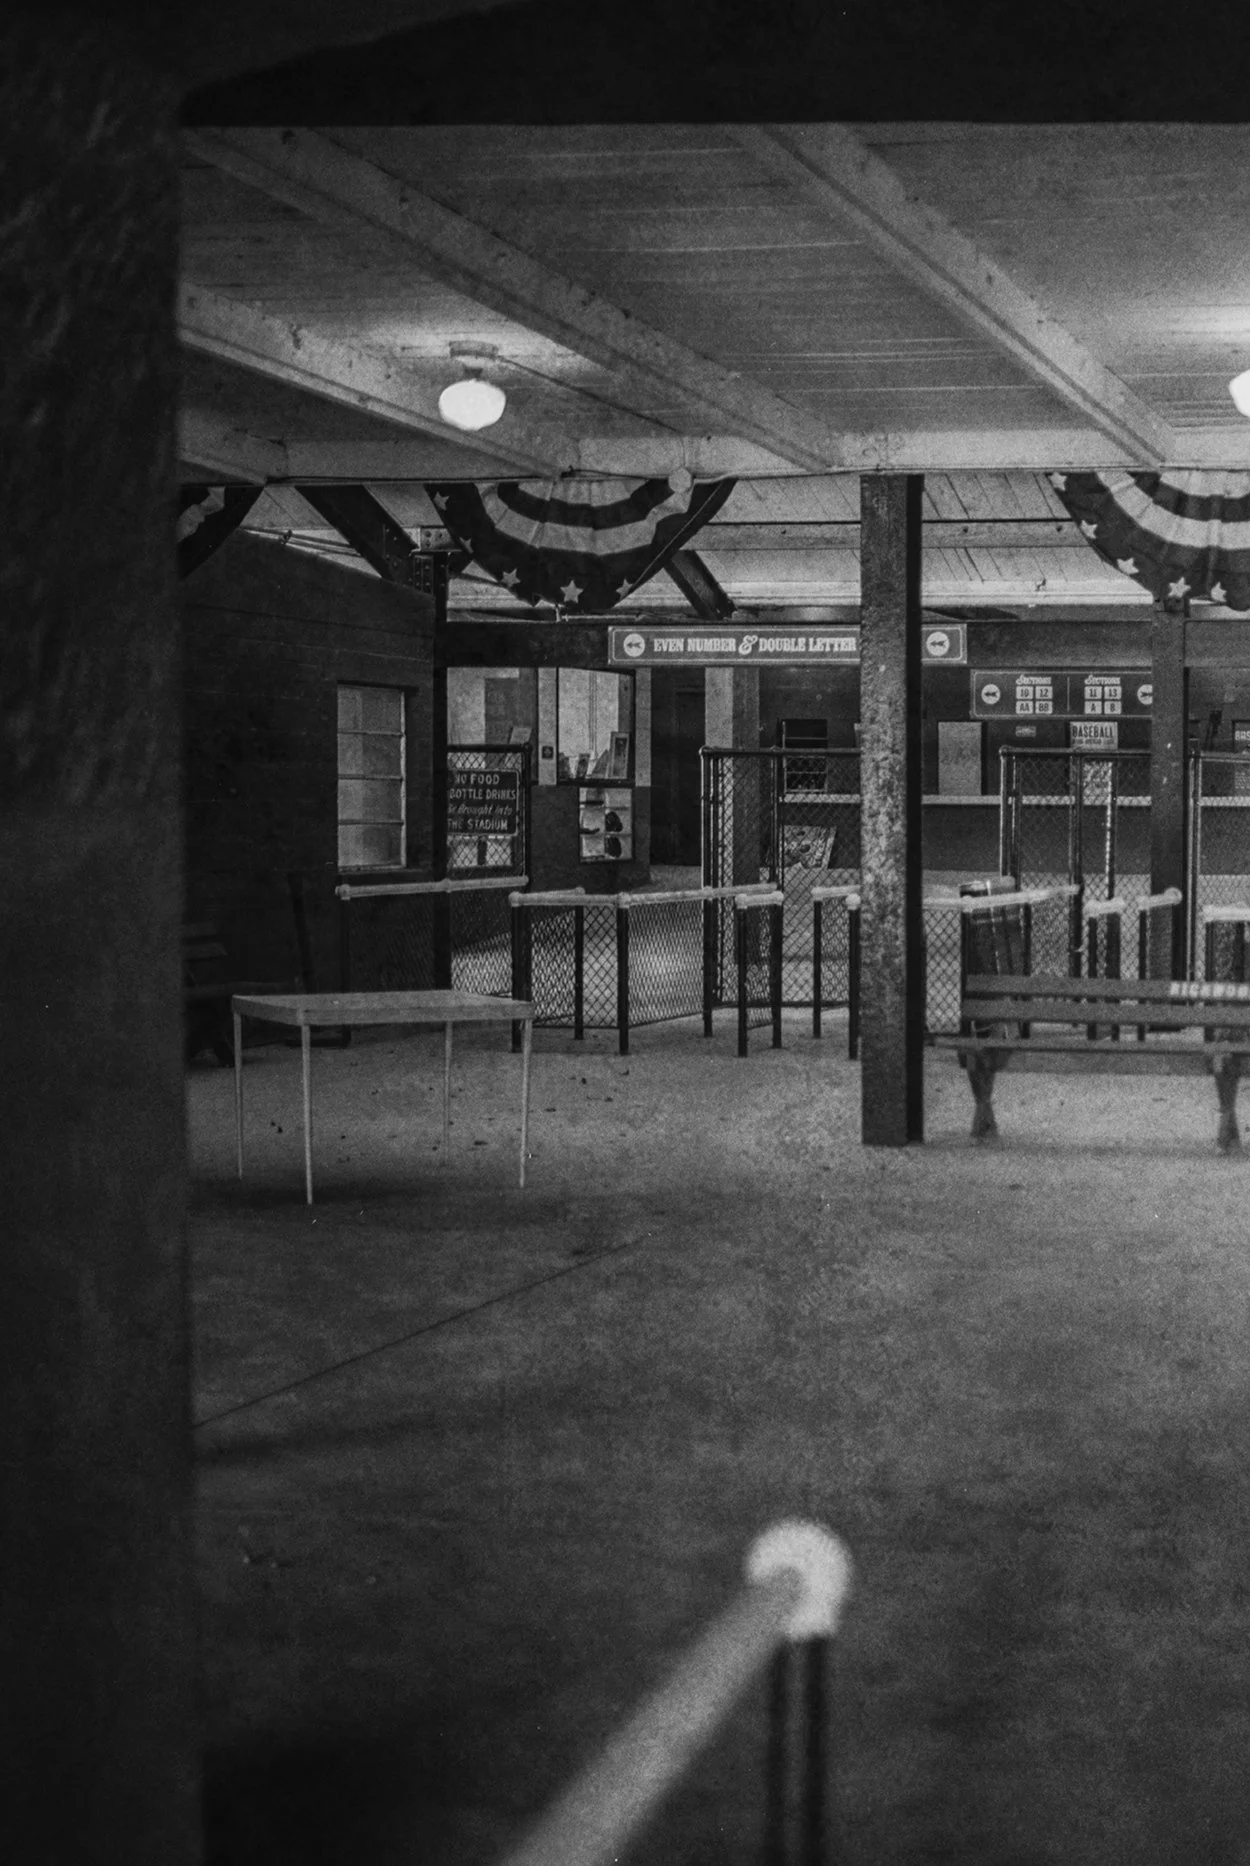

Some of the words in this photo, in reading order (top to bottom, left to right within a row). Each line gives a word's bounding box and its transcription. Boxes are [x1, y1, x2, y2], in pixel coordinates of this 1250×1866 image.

[653, 637, 686, 653] EVEN
[687, 637, 736, 653] NUMBER
[758, 637, 806, 653] DOUBLE
[807, 637, 856, 653] LETTER
[1020, 688, 1030, 698] 10
[1039, 688, 1049, 698] 12
[1089, 688, 1098, 698] 11
[1108, 688, 1118, 698] 13
[1019, 703, 1031, 713] AA
[1072, 725, 1114, 738] BASEBALL
[470, 773, 500, 785] FOOD
[485, 788, 516, 800] DRINKS
[467, 818, 508, 831] STADIUM
